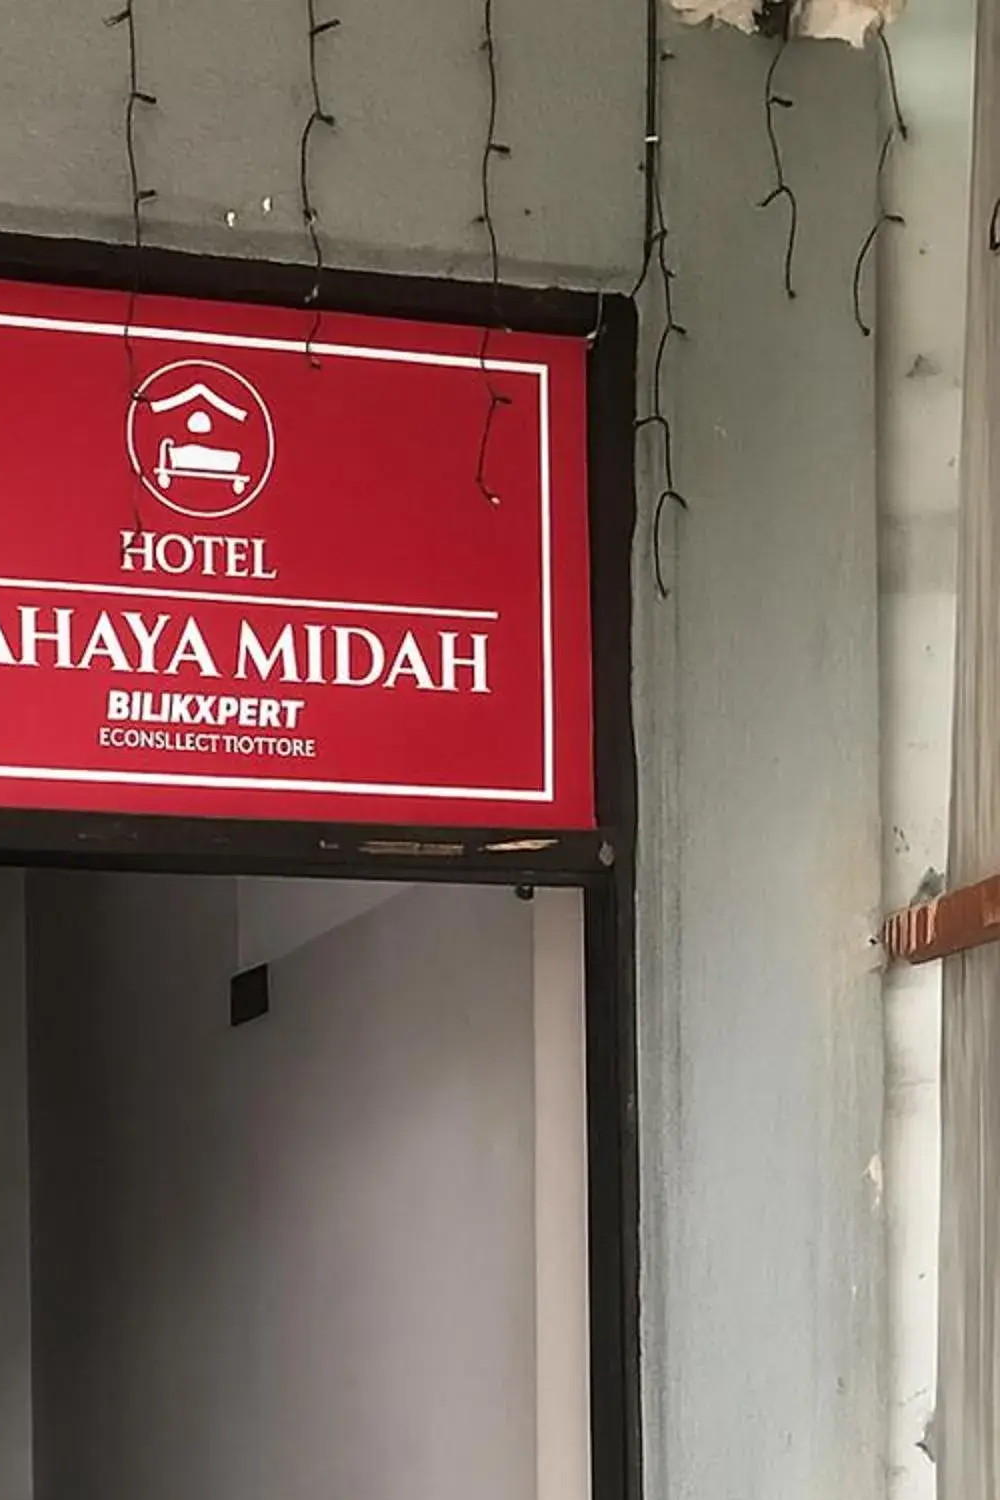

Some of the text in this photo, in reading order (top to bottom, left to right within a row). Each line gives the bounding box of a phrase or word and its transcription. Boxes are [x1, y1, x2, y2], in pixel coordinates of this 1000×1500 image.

[119, 529, 278, 579] HOTEL
[233, 619, 491, 693] MIDAH
[107, 690, 305, 729] BILIKXPERT
